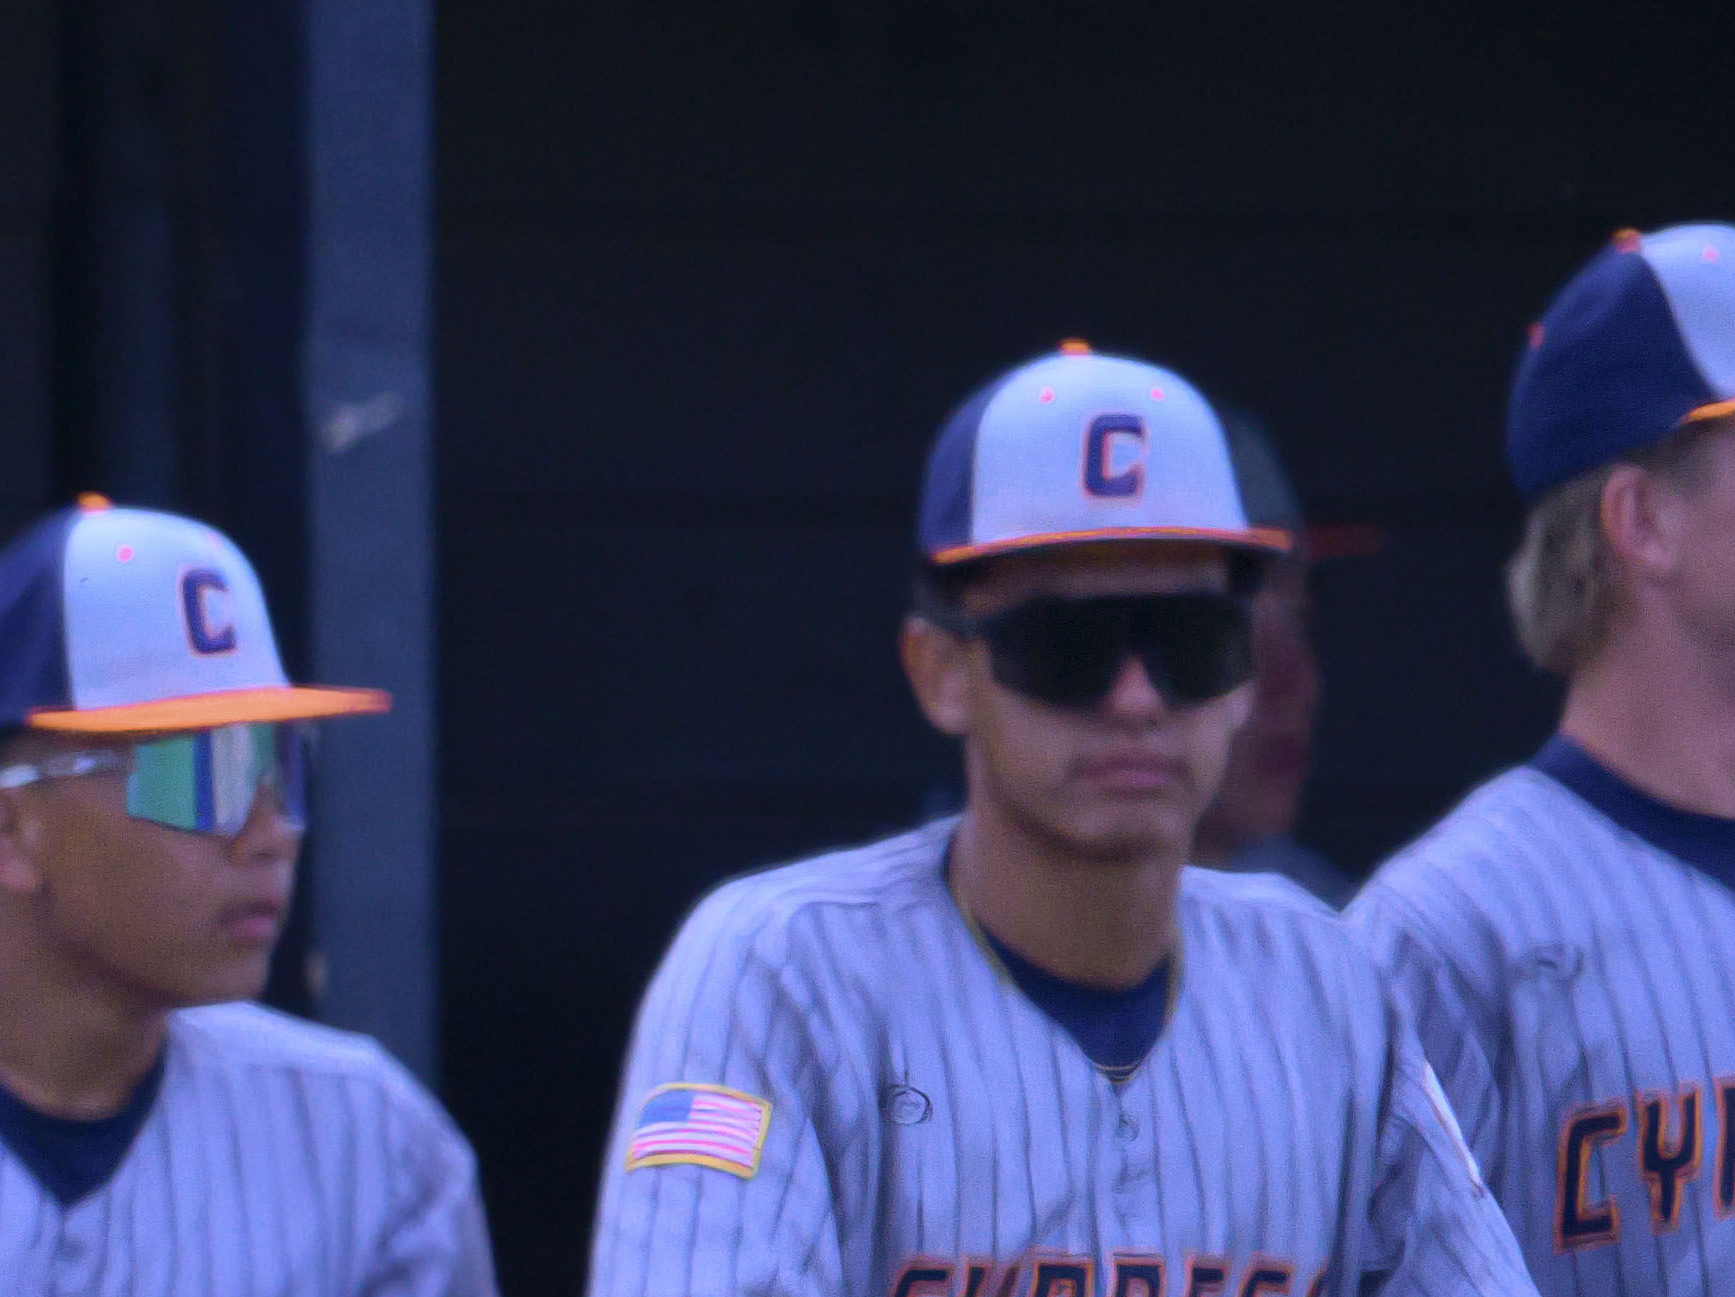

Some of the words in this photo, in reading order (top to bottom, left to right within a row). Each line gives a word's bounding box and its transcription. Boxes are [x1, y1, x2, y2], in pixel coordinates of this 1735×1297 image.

[1079, 410, 1148, 503] C
[178, 566, 239, 657] C
[1553, 1071, 1735, 1256] CY
